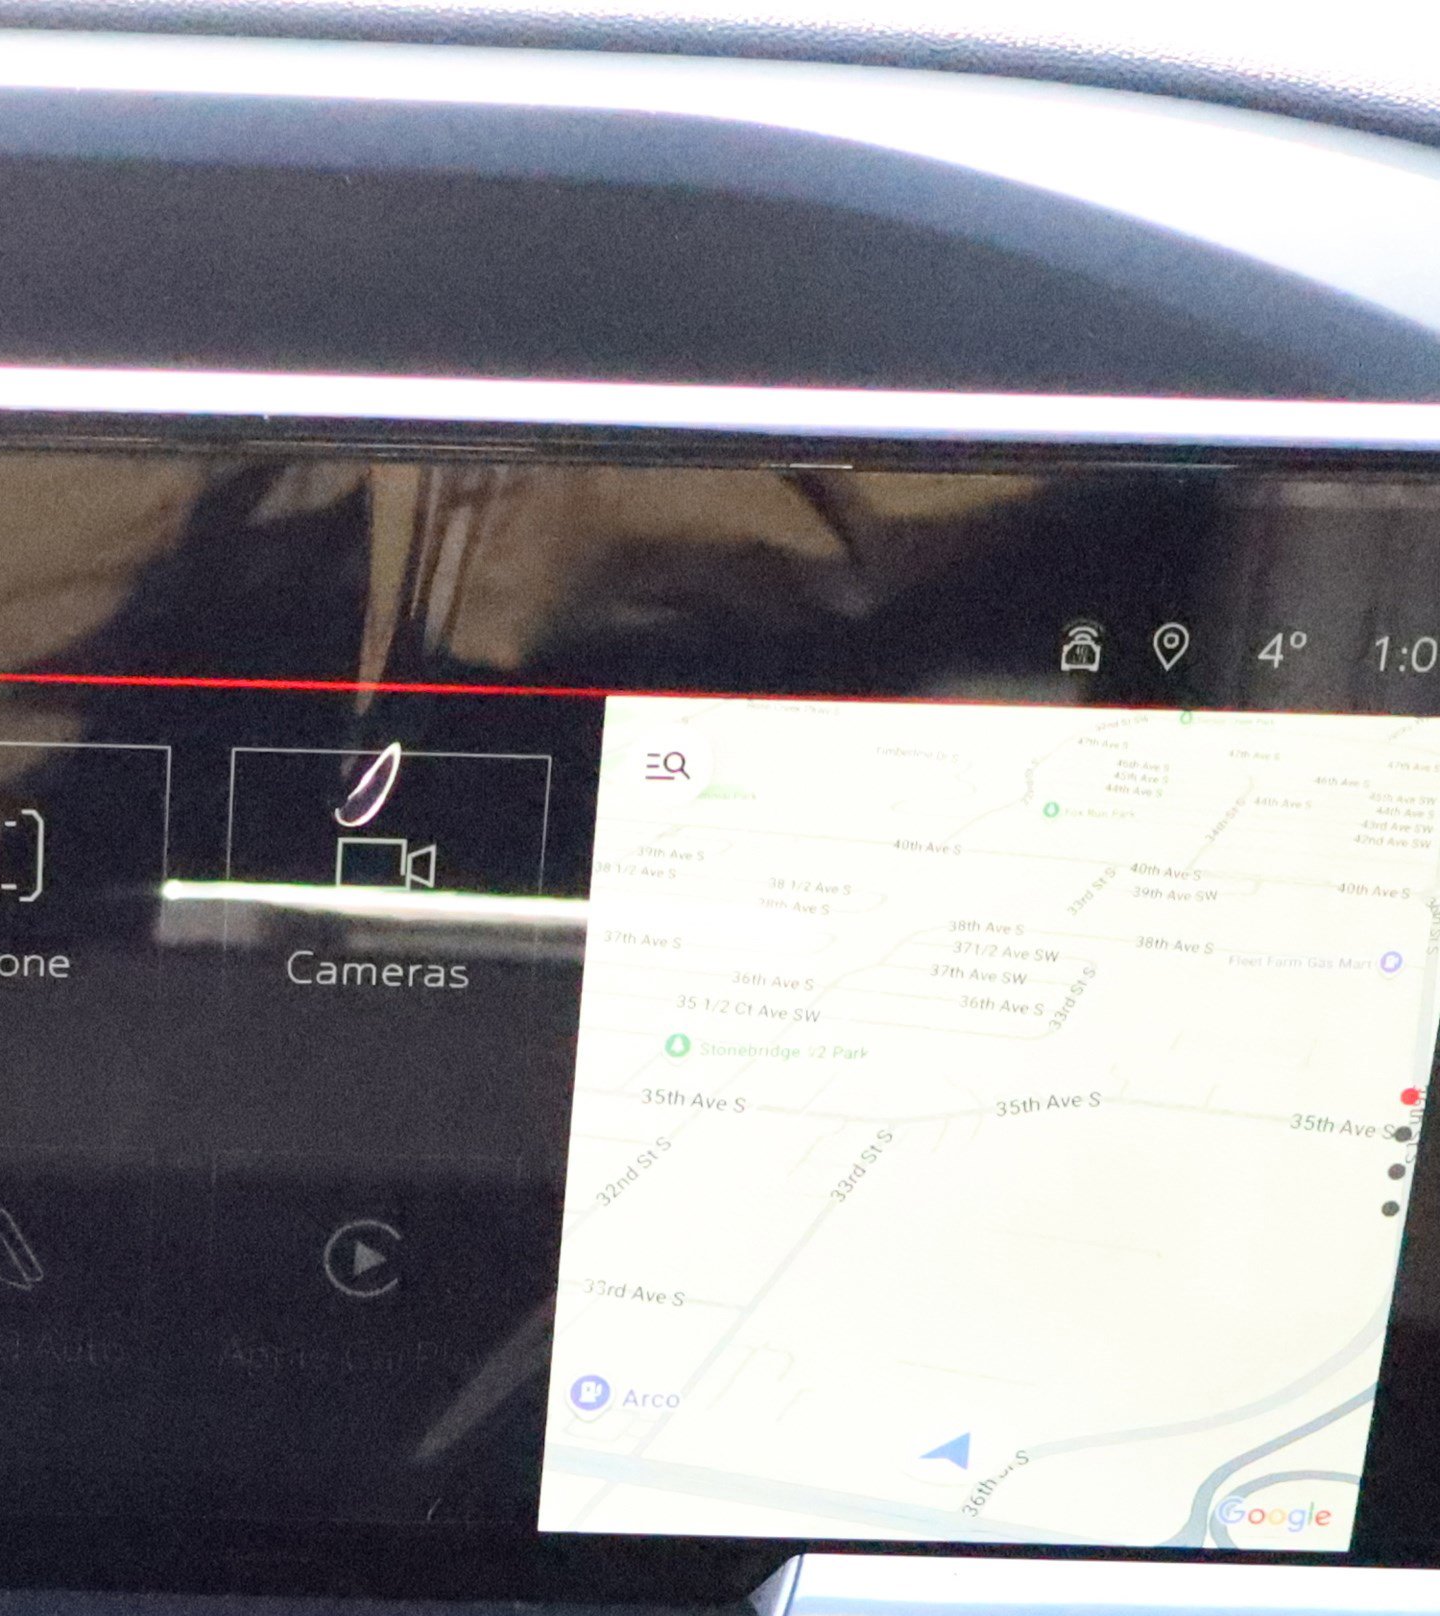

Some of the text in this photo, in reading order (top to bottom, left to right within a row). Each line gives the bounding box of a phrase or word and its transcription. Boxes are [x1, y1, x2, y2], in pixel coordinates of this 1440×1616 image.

[893, 839, 961, 856] 40th Ave S
[1130, 862, 1202, 881] 40th Ave S
[1067, 867, 1116, 917] 33rd St S
[1133, 886, 1218, 901] 39th Ave SW
[1337, 882, 1411, 899] 40th Ave S
[948, 920, 1024, 936] 38th Ave S
[1002, 945, 1029, 960] Ave
[1034, 949, 1060, 962] SW
[1136, 936, 1215, 954] 38th Ave S
[287, 950, 469, 988] Cameras
[1229, 955, 1372, 970] Fleet Farm Gas Mart
[930, 964, 1027, 985] 37th Ave SW
[959, 995, 1044, 1016] 36th Ave S
[1049, 966, 1096, 1030] 33rd St S
[700, 1041, 800, 1061] Stonebridge
[833, 1046, 869, 1060] Park
[641, 1088, 747, 1113] 35th Ave S
[996, 1092, 1101, 1117] 35th Ave S
[1290, 1113, 1395, 1140] 35th Ave S
[596, 1136, 672, 1207] 32nd St S
[830, 1129, 894, 1202] 33rd St S
[583, 1278, 685, 1307] 33rd Ave S
[622, 1389, 680, 1409] Arco
[1217, 1496, 1332, 1533] Google
